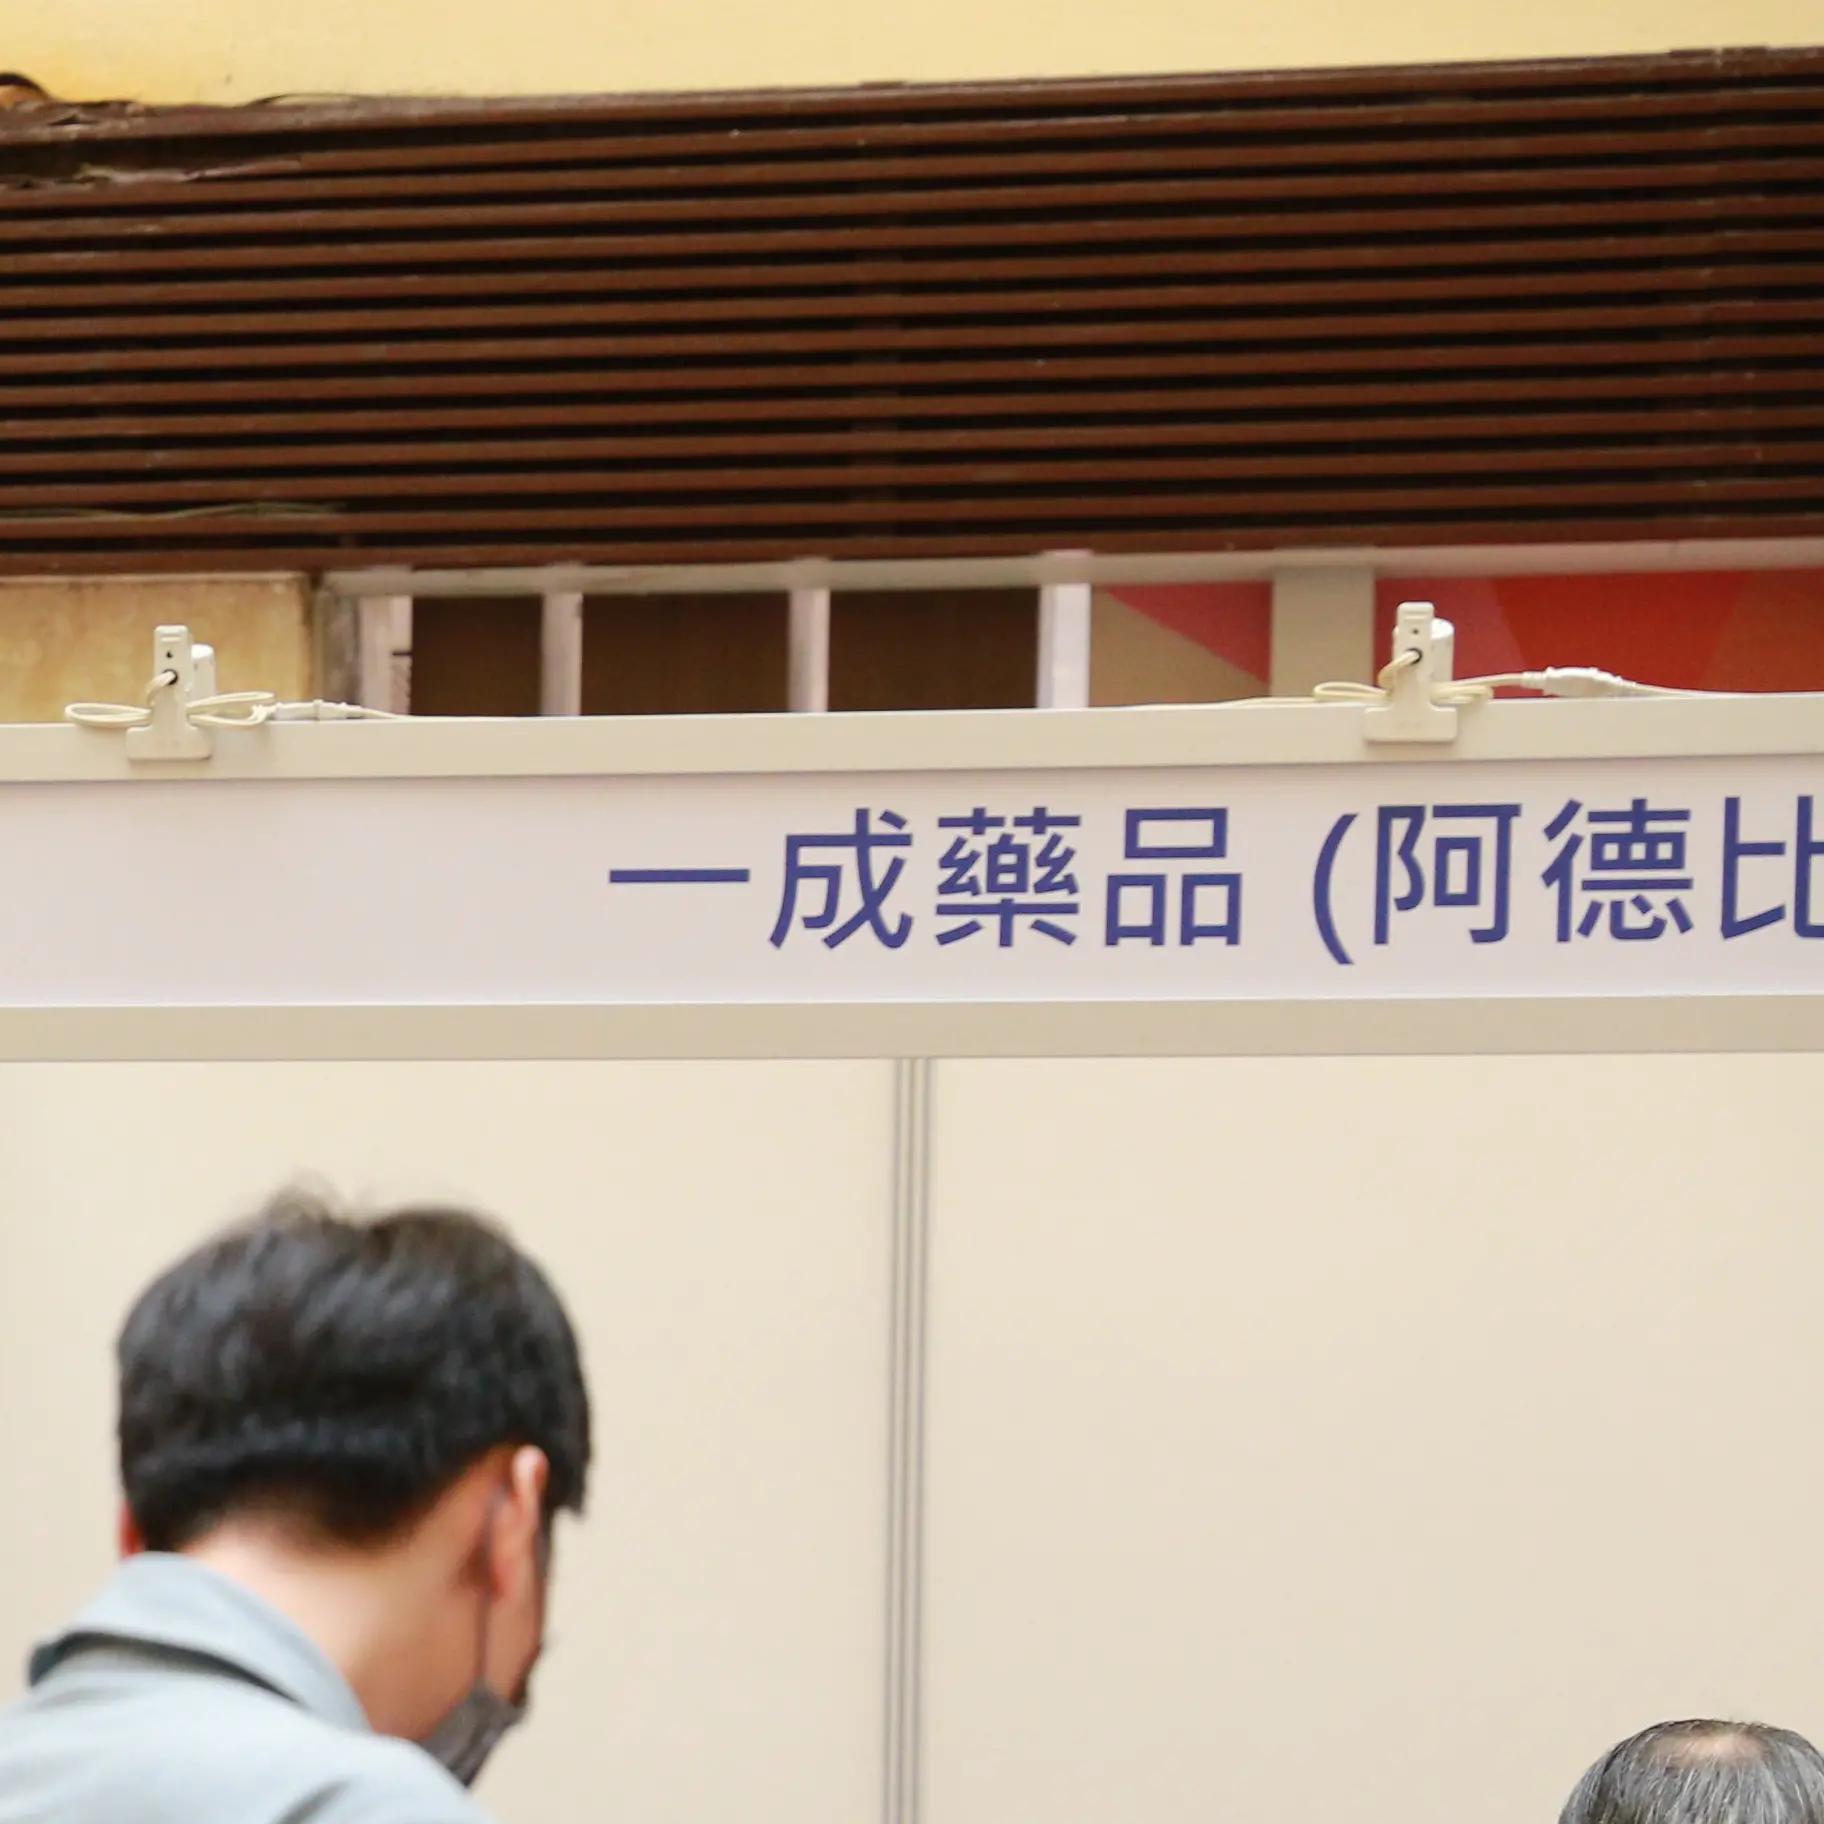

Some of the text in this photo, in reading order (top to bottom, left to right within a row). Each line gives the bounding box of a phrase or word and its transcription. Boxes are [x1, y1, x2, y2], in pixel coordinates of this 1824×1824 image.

[608, 794, 1824, 966] 一成藥品 (阿德比
